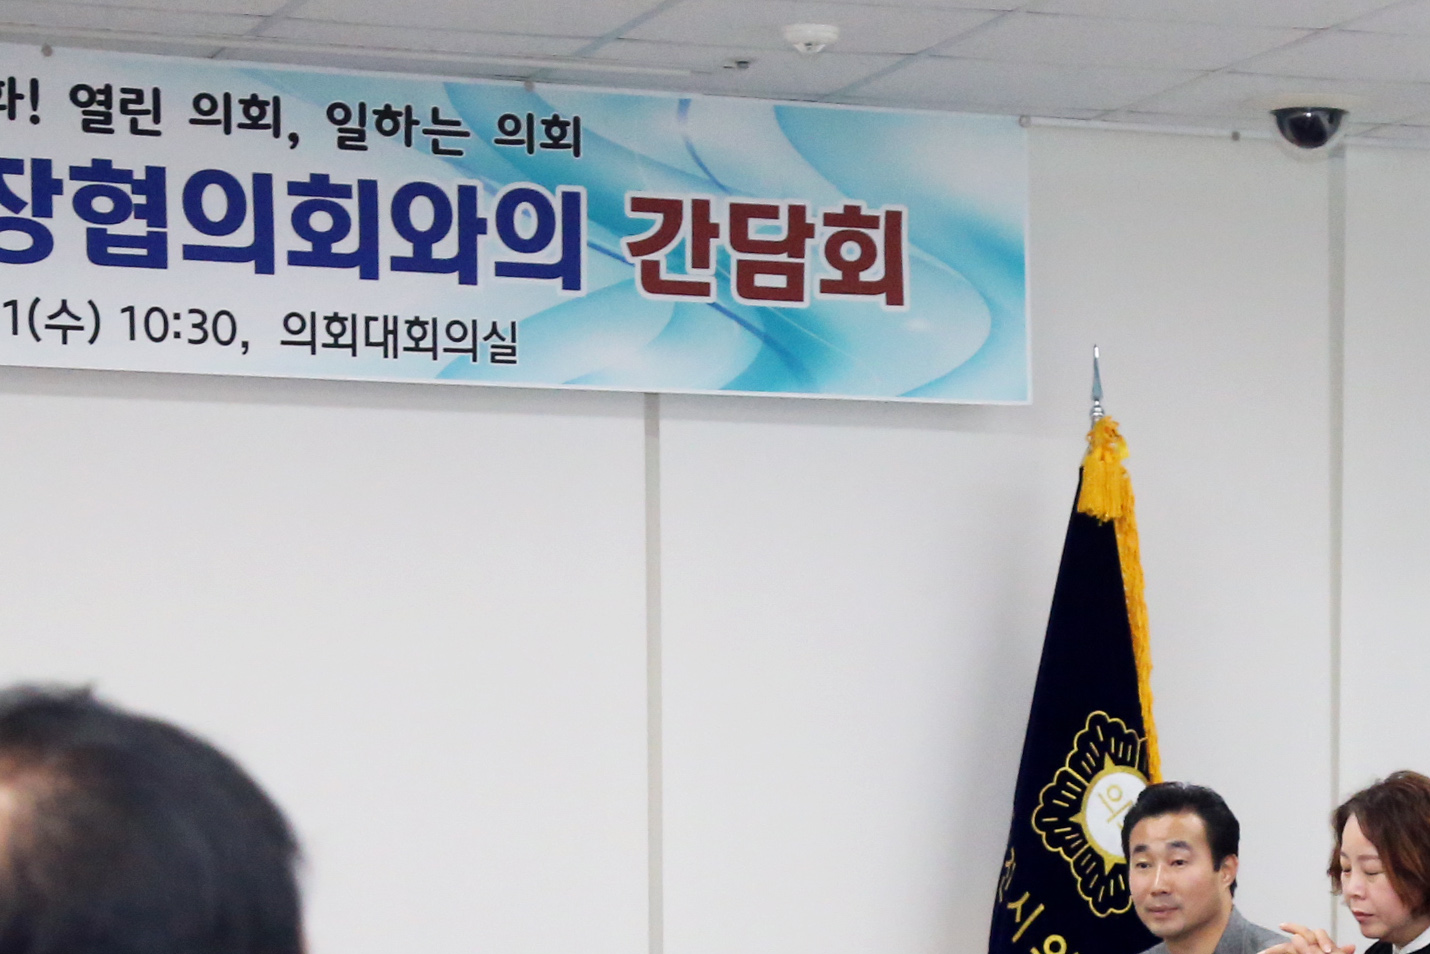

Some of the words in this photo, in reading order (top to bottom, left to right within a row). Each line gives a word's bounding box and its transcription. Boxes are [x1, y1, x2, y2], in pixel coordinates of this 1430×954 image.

[69, 82, 162, 137] 열린
[188, 91, 299, 149] 의회,
[326, 101, 470, 157] 일하는
[494, 112, 582, 158] 의회
[626, 196, 905, 306] 간담회
[120, 305, 250, 354] 10:30,
[280, 310, 518, 364] 의회대회의실
